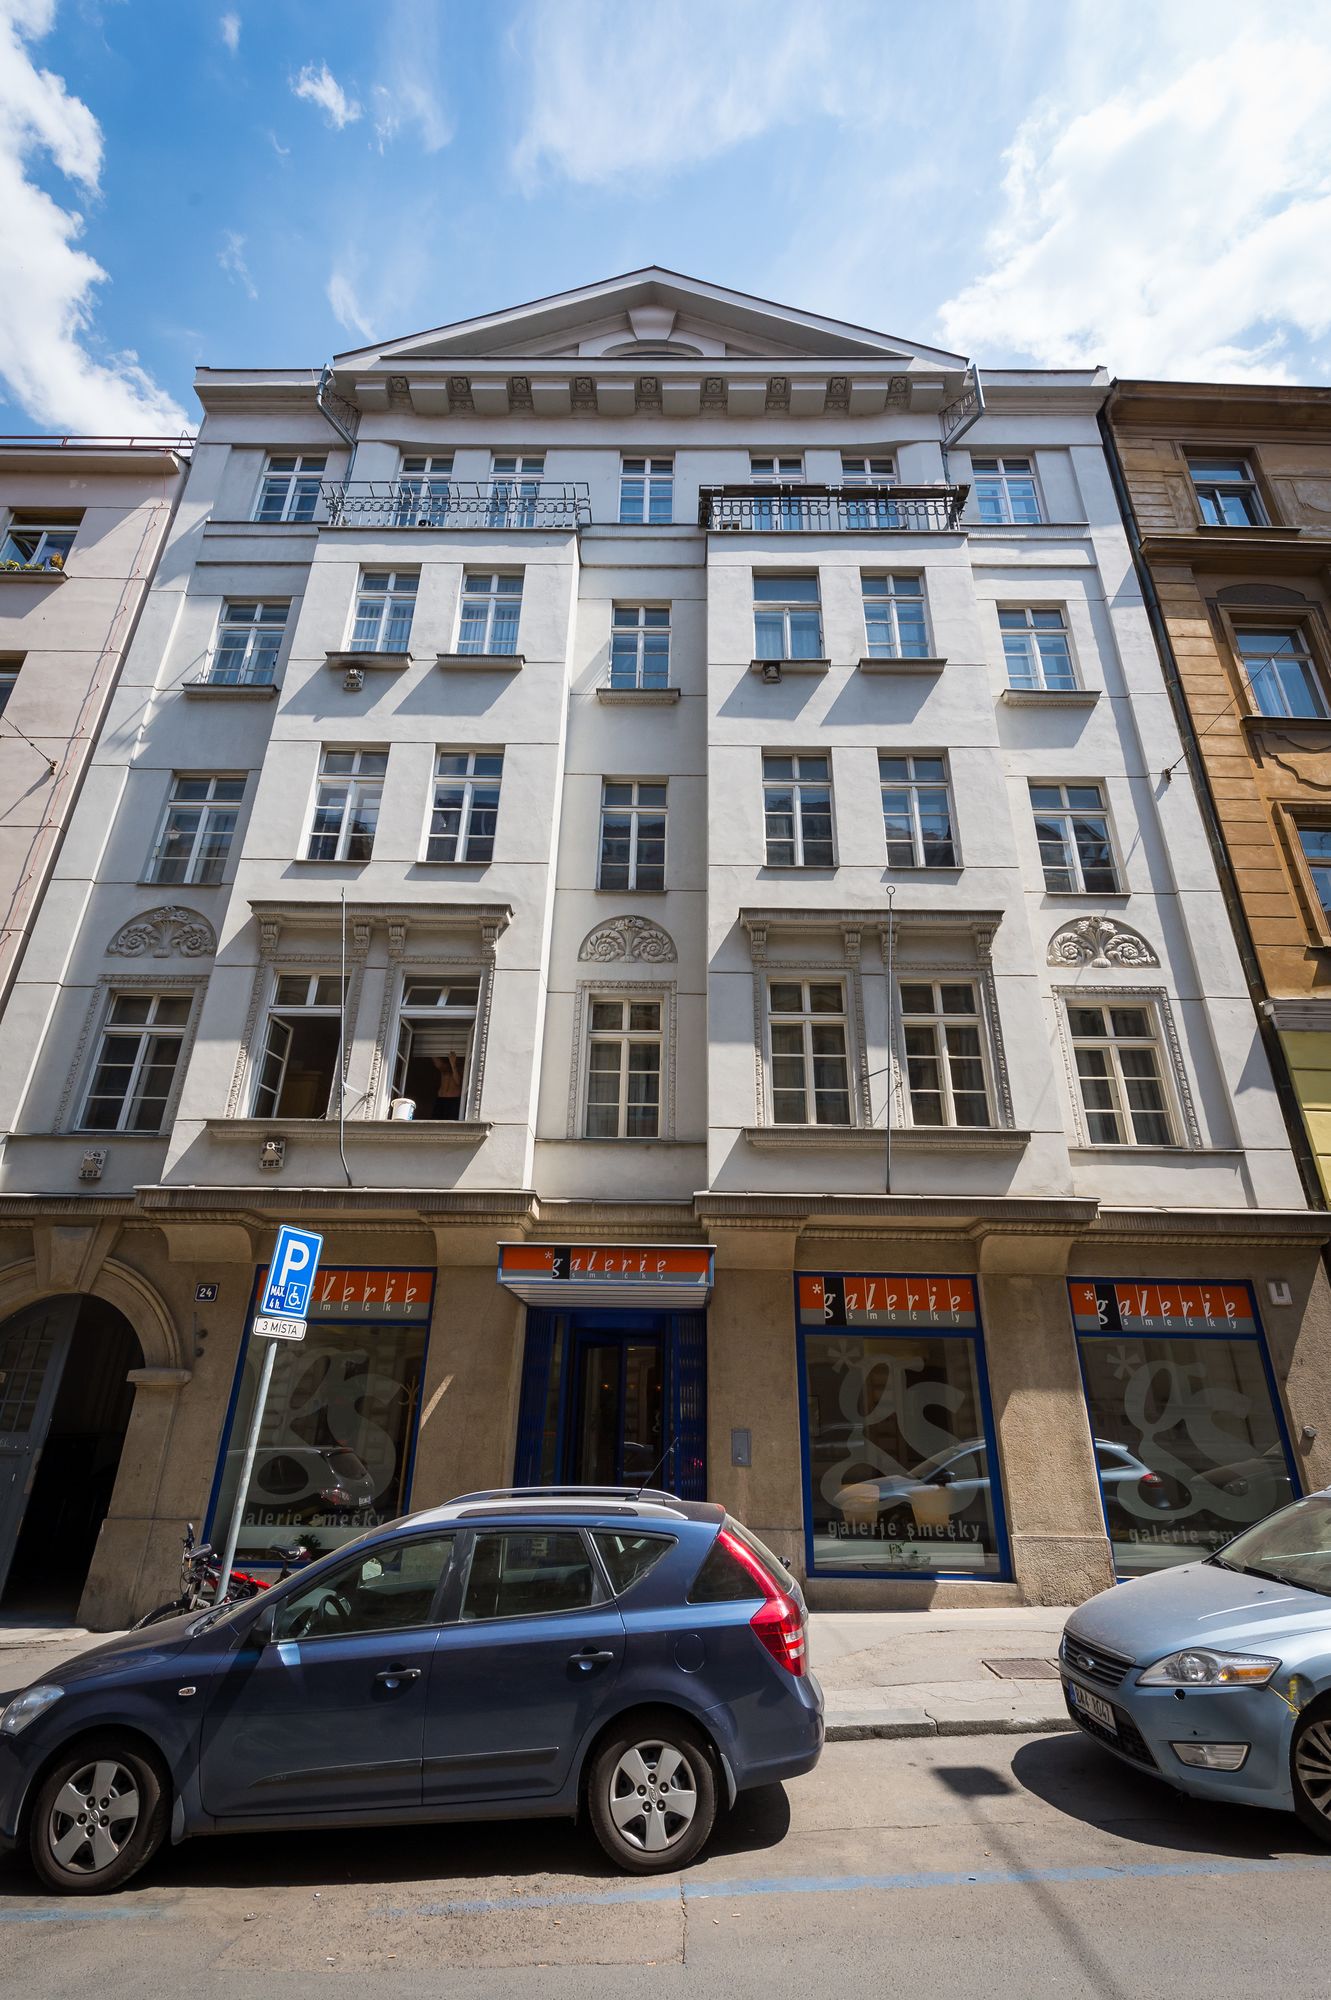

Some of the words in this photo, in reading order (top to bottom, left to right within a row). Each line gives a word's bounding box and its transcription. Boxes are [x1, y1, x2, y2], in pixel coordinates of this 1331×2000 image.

[279, 1239, 310, 1286] P
[552, 1251, 667, 1278] galerie
[199, 1287, 212, 1298] 24
[310, 1275, 417, 1303] lerie
[322, 1302, 412, 1313] mečky
[823, 1283, 961, 1319] galerie
[1096, 1290, 1236, 1325] galerie
[262, 1320, 268, 1331] 3
[848, 1312, 960, 1323] smečky
[1123, 1317, 1238, 1329] smečky
[245, 1508, 303, 1527] alerie
[827, 1517, 897, 1538] galerie
[906, 1519, 980, 1542] smečky
[1128, 1525, 1200, 1545] galerie
